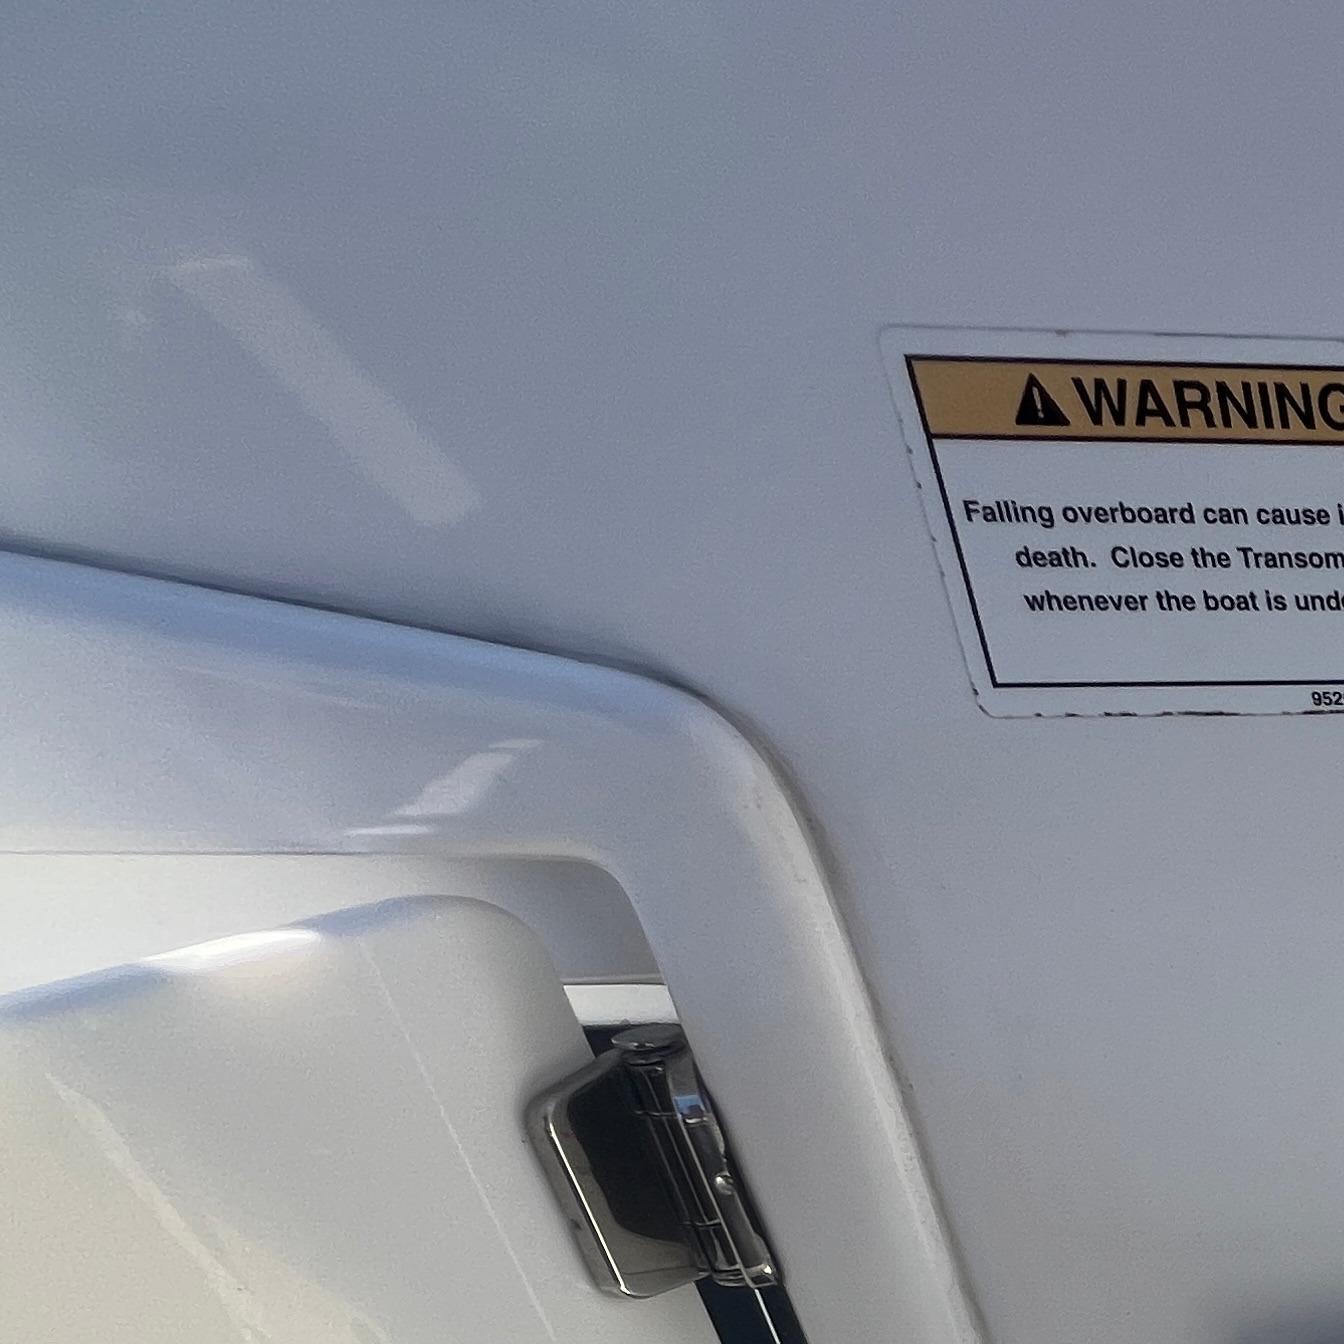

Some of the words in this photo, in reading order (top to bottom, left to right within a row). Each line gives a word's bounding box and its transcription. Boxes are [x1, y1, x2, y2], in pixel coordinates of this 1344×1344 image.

[963, 500, 1055, 528] Falling
[1062, 502, 1196, 525] overboard
[1203, 506, 1248, 526] can
[1256, 506, 1330, 526] cause
[1016, 547, 1096, 569] death.
[1112, 547, 1184, 569] Close
[1191, 547, 1231, 569] the
[1024, 591, 1148, 612] whenever
[1156, 591, 1196, 612] the
[1204, 591, 1259, 612] boat
[1266, 591, 1288, 612] is
